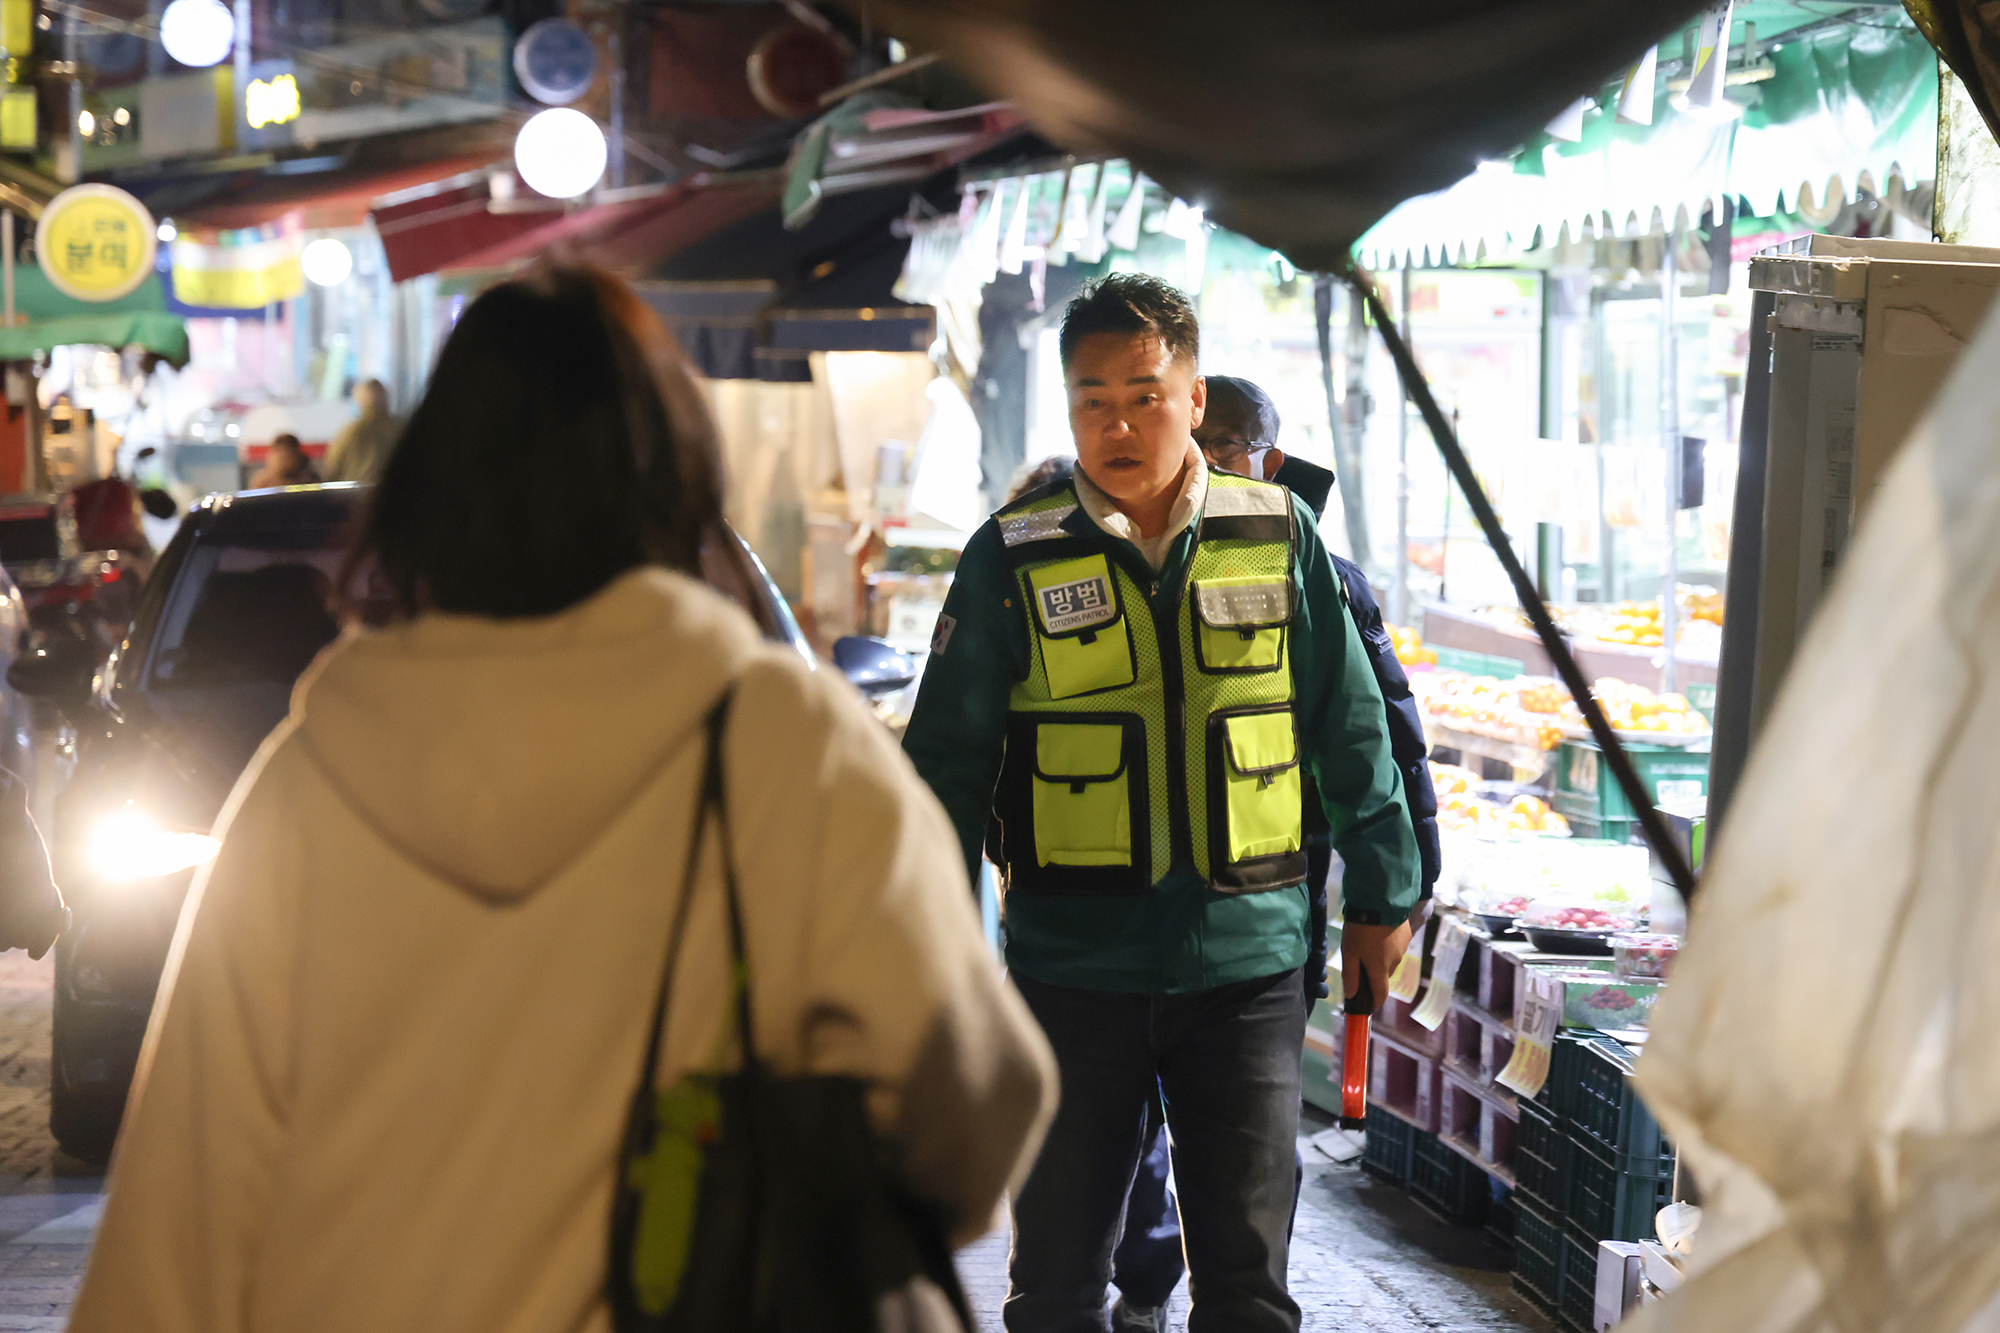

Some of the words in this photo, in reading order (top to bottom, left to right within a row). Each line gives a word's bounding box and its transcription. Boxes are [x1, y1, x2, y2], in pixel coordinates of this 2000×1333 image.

[1049, 580, 1101, 615] 방범
[1049, 614, 1081, 629] CITIZENS
[1082, 608, 1110, 622] PATROL
